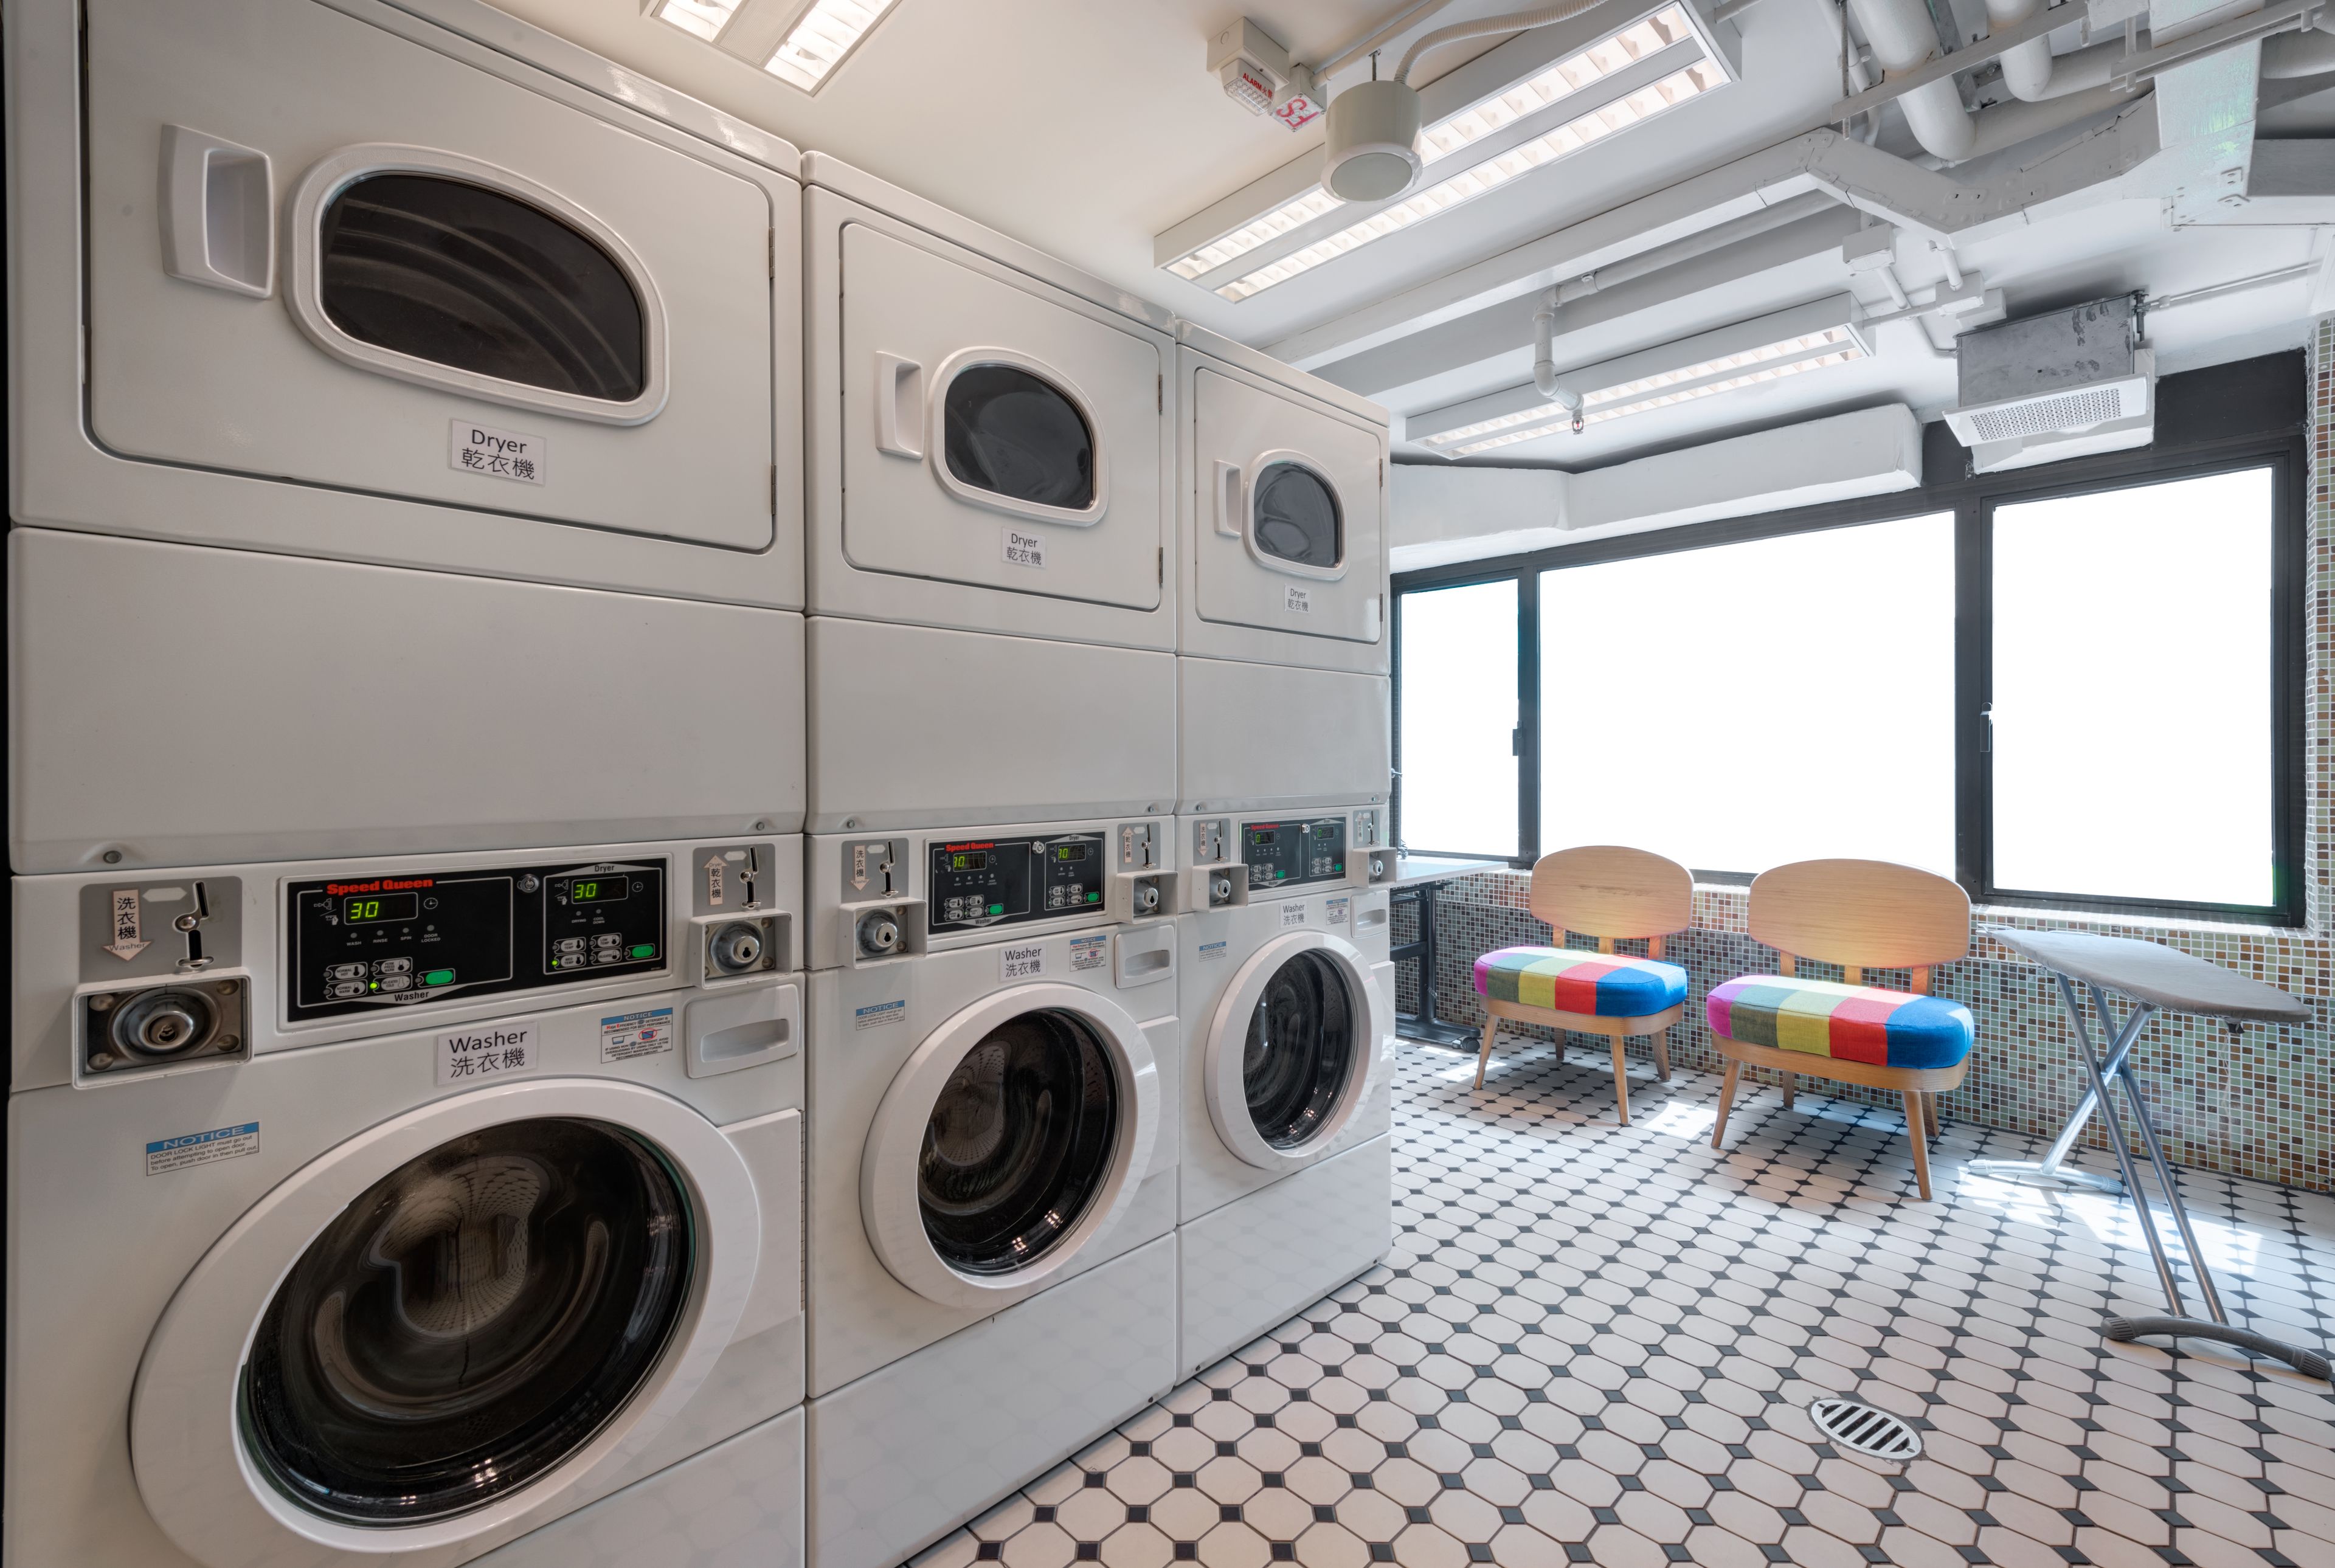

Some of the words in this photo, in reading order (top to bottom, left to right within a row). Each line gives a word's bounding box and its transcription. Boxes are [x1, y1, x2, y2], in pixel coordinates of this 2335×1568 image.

[1242, 72, 1262, 91] ALARM
[472, 429, 527, 454] Dryer
[461, 447, 534, 480] 乾衣機
[1011, 533, 1037, 548] Dryer
[1007, 546, 1041, 565] 乾衣機
[1290, 589, 1306, 599] Dryer
[946, 844, 970, 852] Speed
[327, 880, 380, 895] Speed
[382, 879, 433, 889] Queen
[575, 883, 596, 899] 30
[711, 868, 721, 898] 乾衣機
[350, 902, 379, 919] 30
[1283, 903, 1305, 913] Washer
[117, 897, 137, 940] 洗衣機
[1283, 913, 1304, 925] 洗衣機
[1005, 947, 1042, 961] Washer
[1006, 959, 1041, 977] 洗衣機
[395, 991, 429, 1002] Washer
[863, 1002, 899, 1014] NOTICE
[624, 1012, 652, 1021] NOTICE
[449, 1031, 527, 1053] Washer
[451, 1047, 525, 1078] 洗衣機
[164, 1126, 244, 1149] NOTICE
[151, 1151, 172, 1159] DOOR
[173, 1151, 206, 1161] attempting
